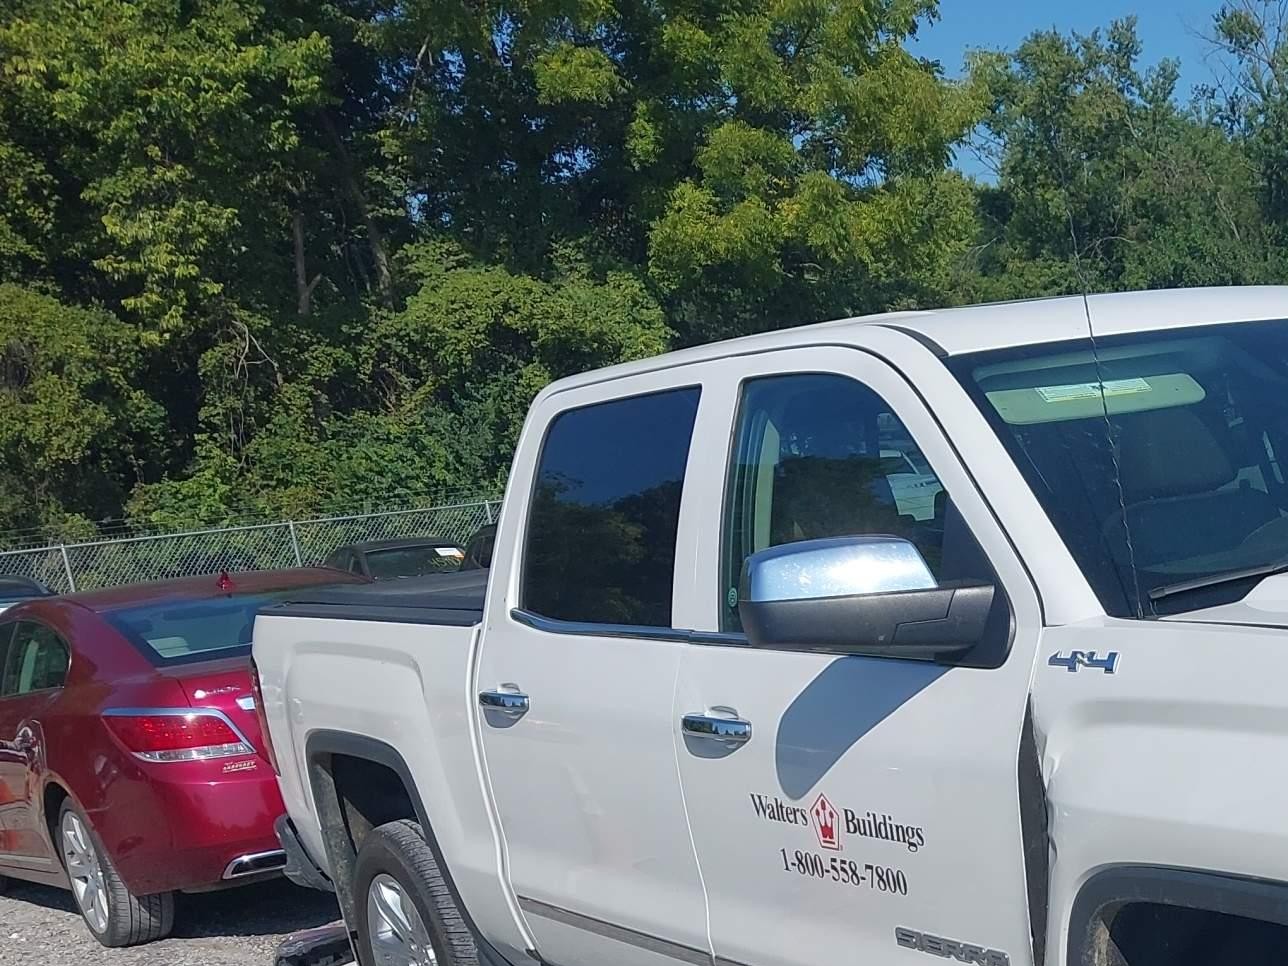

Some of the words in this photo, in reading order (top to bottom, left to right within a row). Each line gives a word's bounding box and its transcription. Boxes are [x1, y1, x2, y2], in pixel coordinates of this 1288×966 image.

[750, 793, 809, 827] Walters
[843, 808, 925, 852] Buildings
[780, 848, 908, 897] 1-800-558-7800
